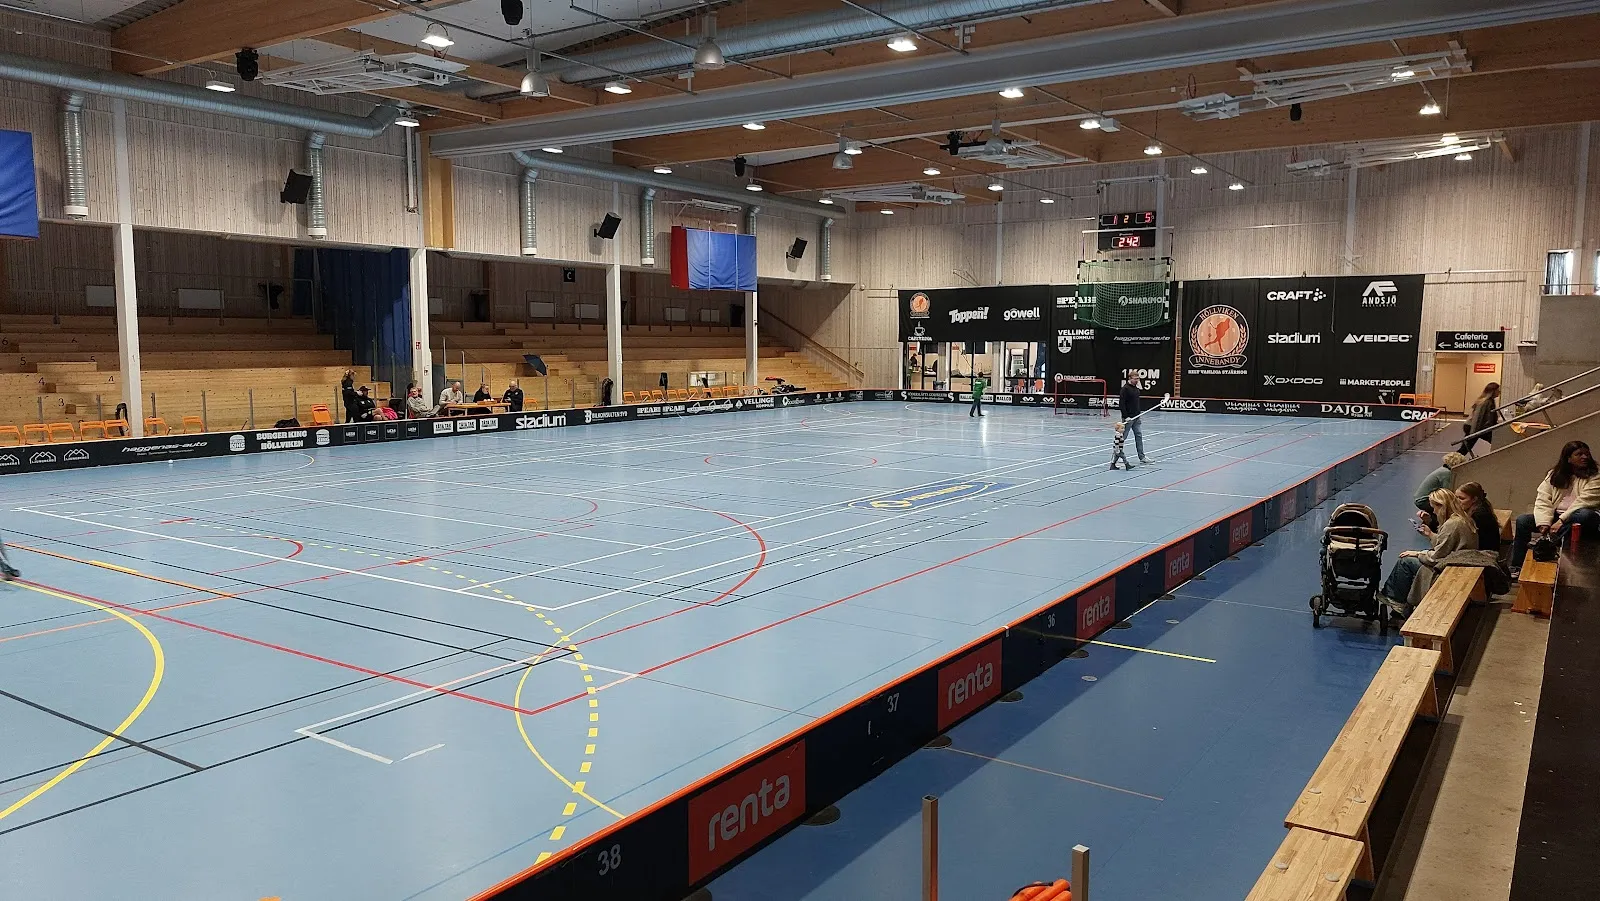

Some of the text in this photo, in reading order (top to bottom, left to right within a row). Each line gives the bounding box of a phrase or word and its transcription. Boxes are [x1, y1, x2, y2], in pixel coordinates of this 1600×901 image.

[1123, 215, 1130, 224] 2
[1144, 212, 1151, 223] 5
[1266, 290, 1313, 301] CRAFT
[1361, 295, 1397, 305] ANDSJÖ
[948, 306, 990, 324] Toppen!
[1199, 307, 1239, 320] HÖLLVIKEN
[1267, 332, 1321, 344] stadium
[1355, 334, 1411, 343] VEIDEC
[1454, 332, 1489, 341] Cafeteria
[1453, 341, 1502, 349] Sektion C & D
[20, 356, 27, 366] 5
[1195, 356, 1241, 366] INNEBANDY
[1275, 377, 1324, 385] OXDOG
[1347, 378, 1411, 387] MARKET.PEOPLE
[58, 397, 65, 406] 3
[743, 396, 775, 405] VELLINGE
[1321, 403, 1373, 416] DAJOL
[1400, 409, 1438, 421] CRAF
[515, 413, 567, 430] stadium
[256, 430, 308, 440] BURGER KING
[261, 440, 304, 450] HÖLLVIKEN
[1169, 551, 1190, 578] renta
[1083, 595, 1110, 630] renta
[1047, 613, 1056, 628] 36
[947, 662, 993, 710] renta
[887, 692, 900, 713] 37
[708, 774, 790, 852] renta
[597, 843, 622, 876] 38
